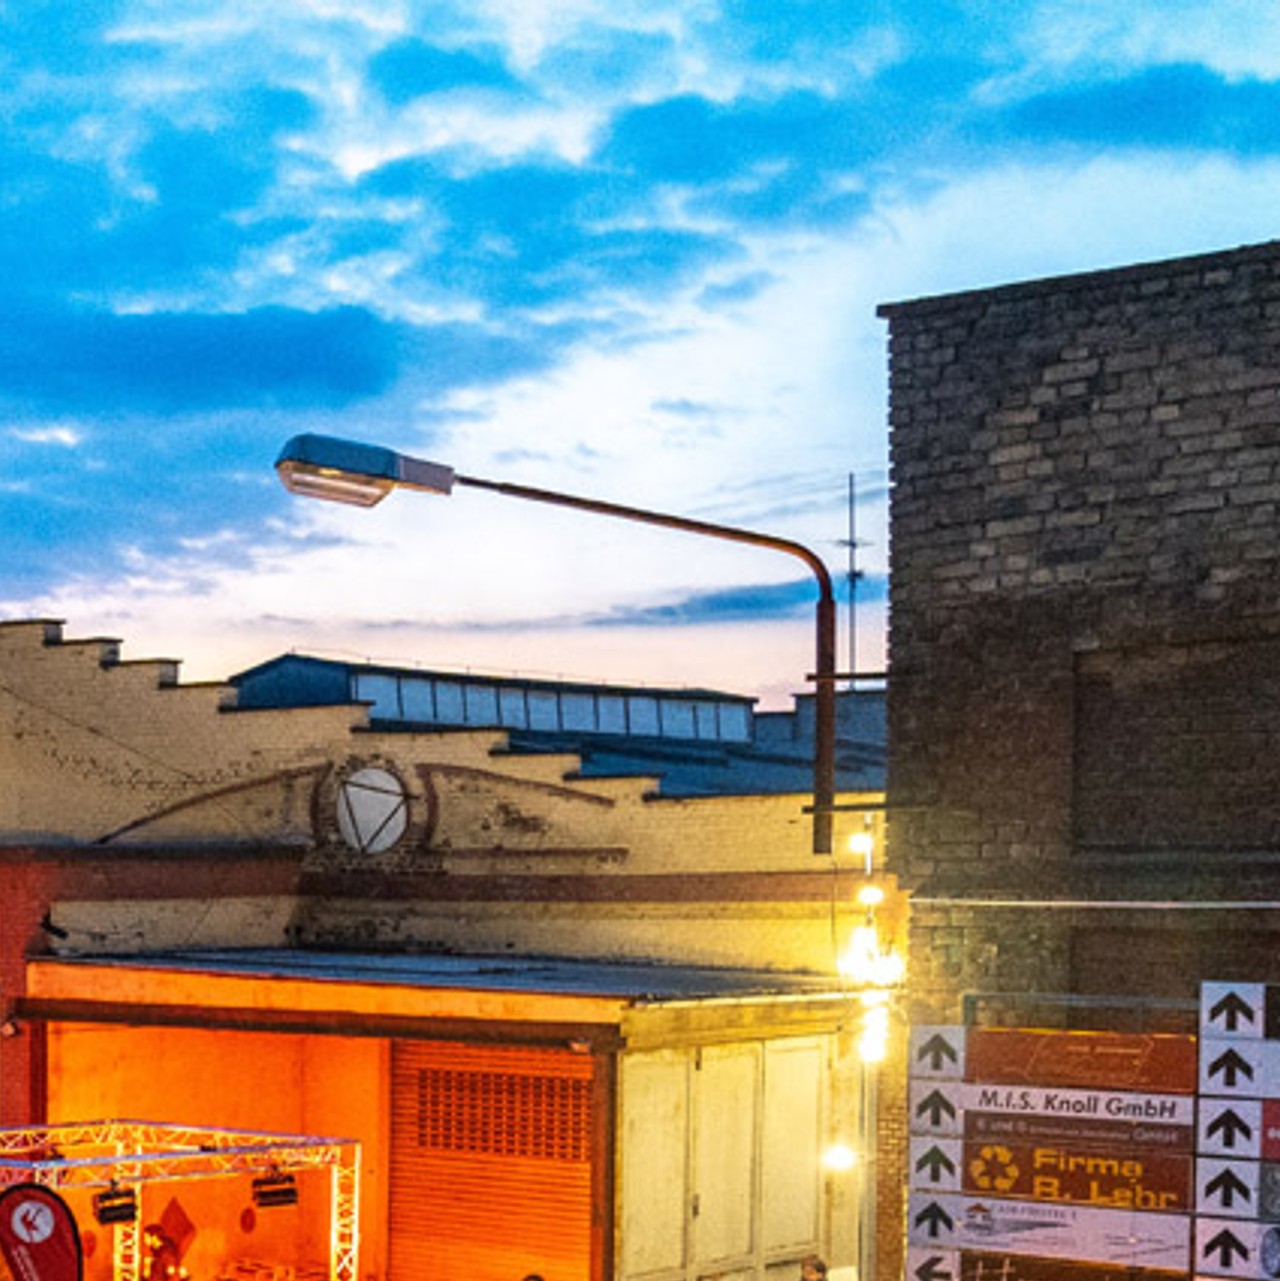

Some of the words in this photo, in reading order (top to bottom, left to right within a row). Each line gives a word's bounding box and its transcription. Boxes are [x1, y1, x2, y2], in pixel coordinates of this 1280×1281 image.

[978, 1090, 1036, 1111] M.I.S.
[1042, 1094, 1099, 1114] Knoll
[1105, 1097, 1177, 1118] GmbH
[1033, 1148, 1143, 1177] Firma
[1033, 1176, 1071, 1200] B.
